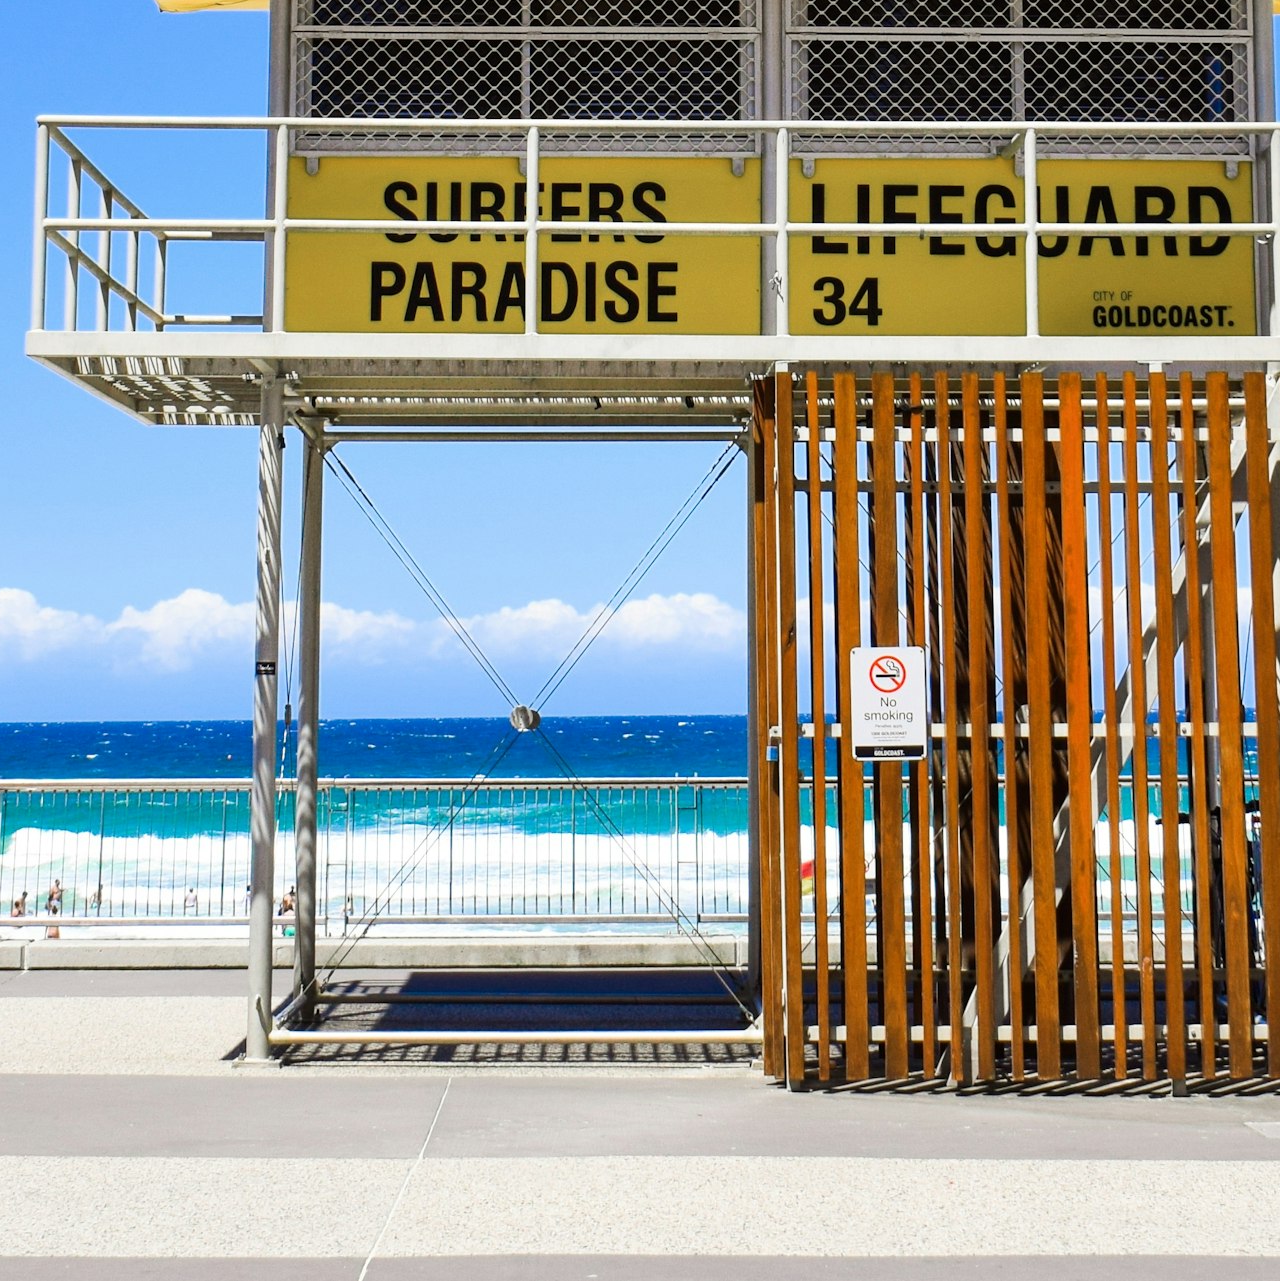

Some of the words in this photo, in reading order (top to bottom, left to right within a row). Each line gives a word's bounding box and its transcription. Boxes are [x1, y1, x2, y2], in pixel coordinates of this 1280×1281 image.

[383, 181, 667, 244] SURFERS
[811, 183, 1233, 258] LIFEGUARD
[370, 261, 679, 323] PARADISE
[812, 276, 883, 327] 34
[1093, 291, 1115, 302] CITY
[1120, 291, 1133, 302] OF
[864, 710, 914, 723] smoking
[880, 697, 897, 707] No
